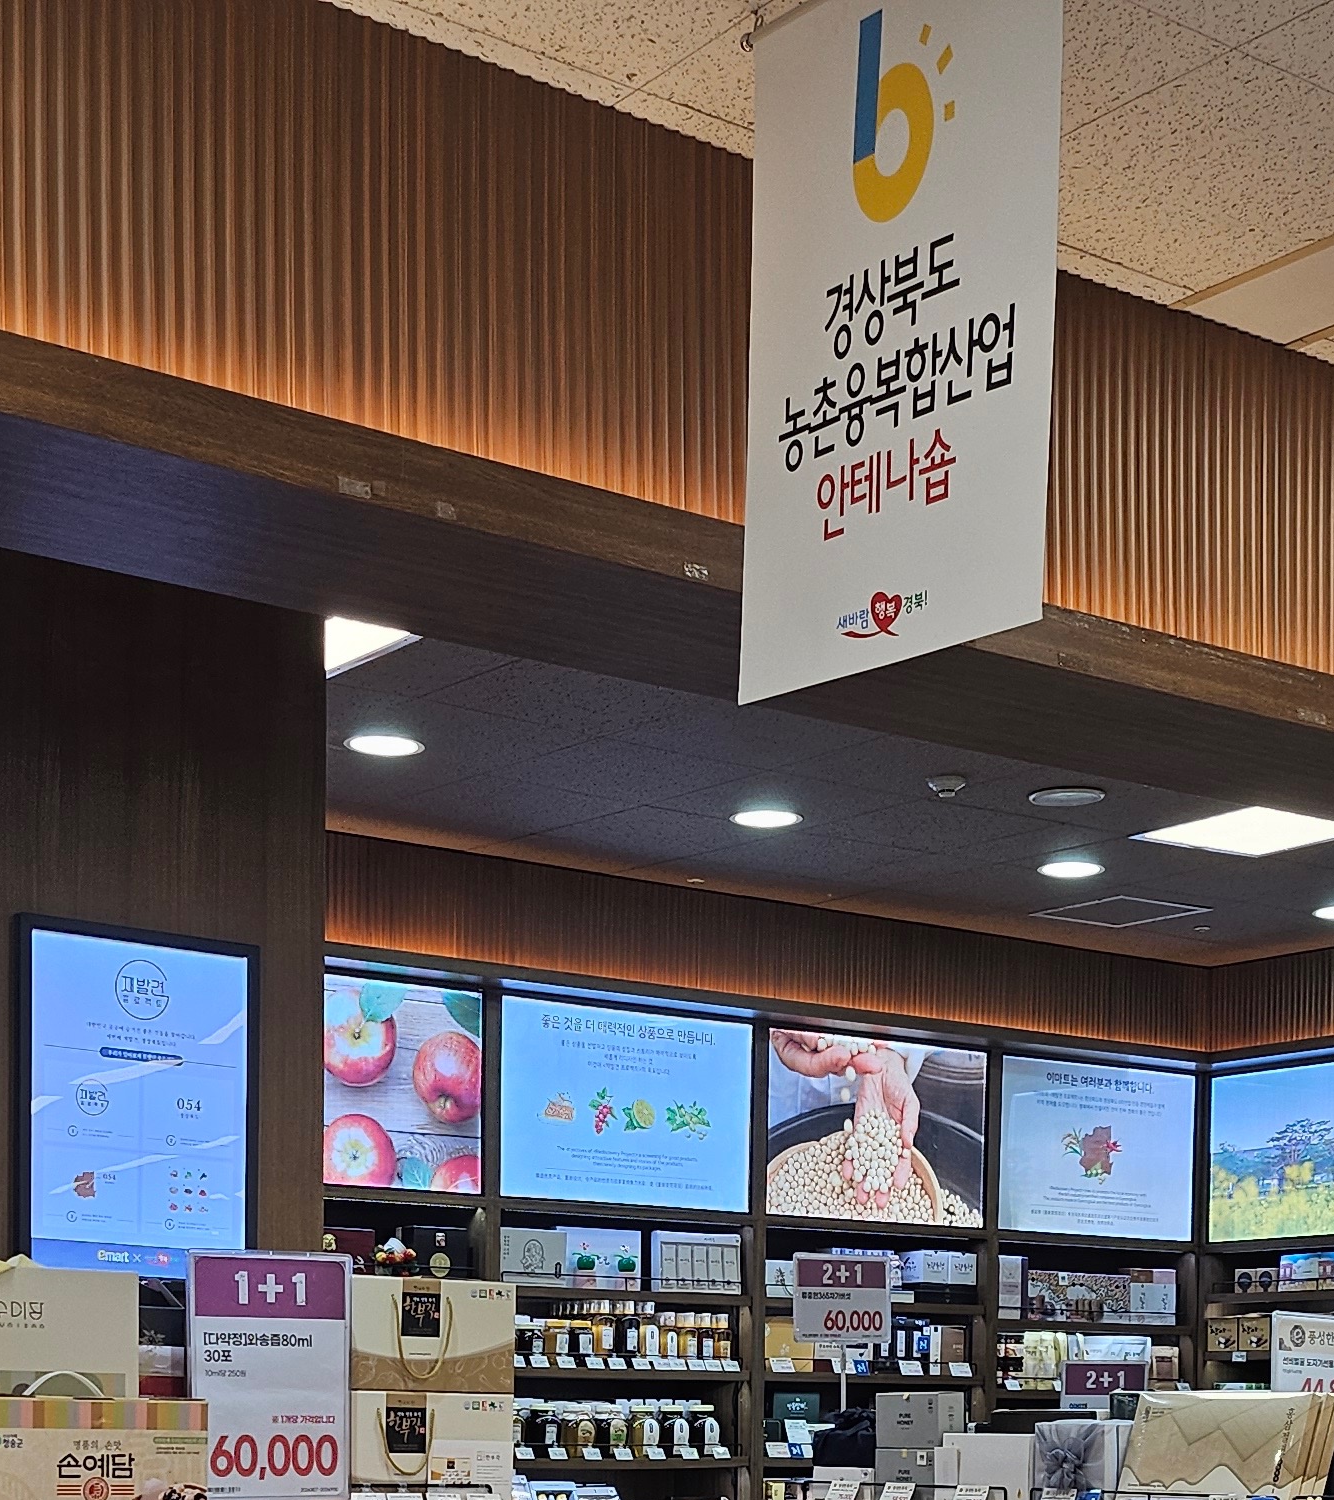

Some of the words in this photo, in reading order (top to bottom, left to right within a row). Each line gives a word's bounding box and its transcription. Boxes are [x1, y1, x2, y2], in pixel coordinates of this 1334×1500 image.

[824, 233, 961, 360] 경상북도
[778, 304, 1015, 473] 농촌융복합산업
[815, 427, 957, 543] 안테나숍
[836, 608, 870, 631] 새바람
[874, 601, 897, 621] 행복
[903, 590, 928, 615] 경북!
[541, 1013, 562, 1031] 좋은
[585, 1018, 596, 1034] 더
[637, 1024, 675, 1042] 상품으로
[1045, 1071, 1079, 1088] 이마트는
[1080, 1074, 1113, 1091] 여러분과
[176, 1097, 203, 1113] 054
[97, 1249, 130, 1264] emart
[822, 1263, 863, 1286] 2+1
[234, 1270, 307, 1307] 1+1
[823, 1309, 883, 1334] 60,000
[203, 1348, 233, 1364] 30포
[1086, 1370, 1126, 1390] 2+1
[56, 1452, 136, 1479] 손예담
[210, 1434, 339, 1481] 60,000
